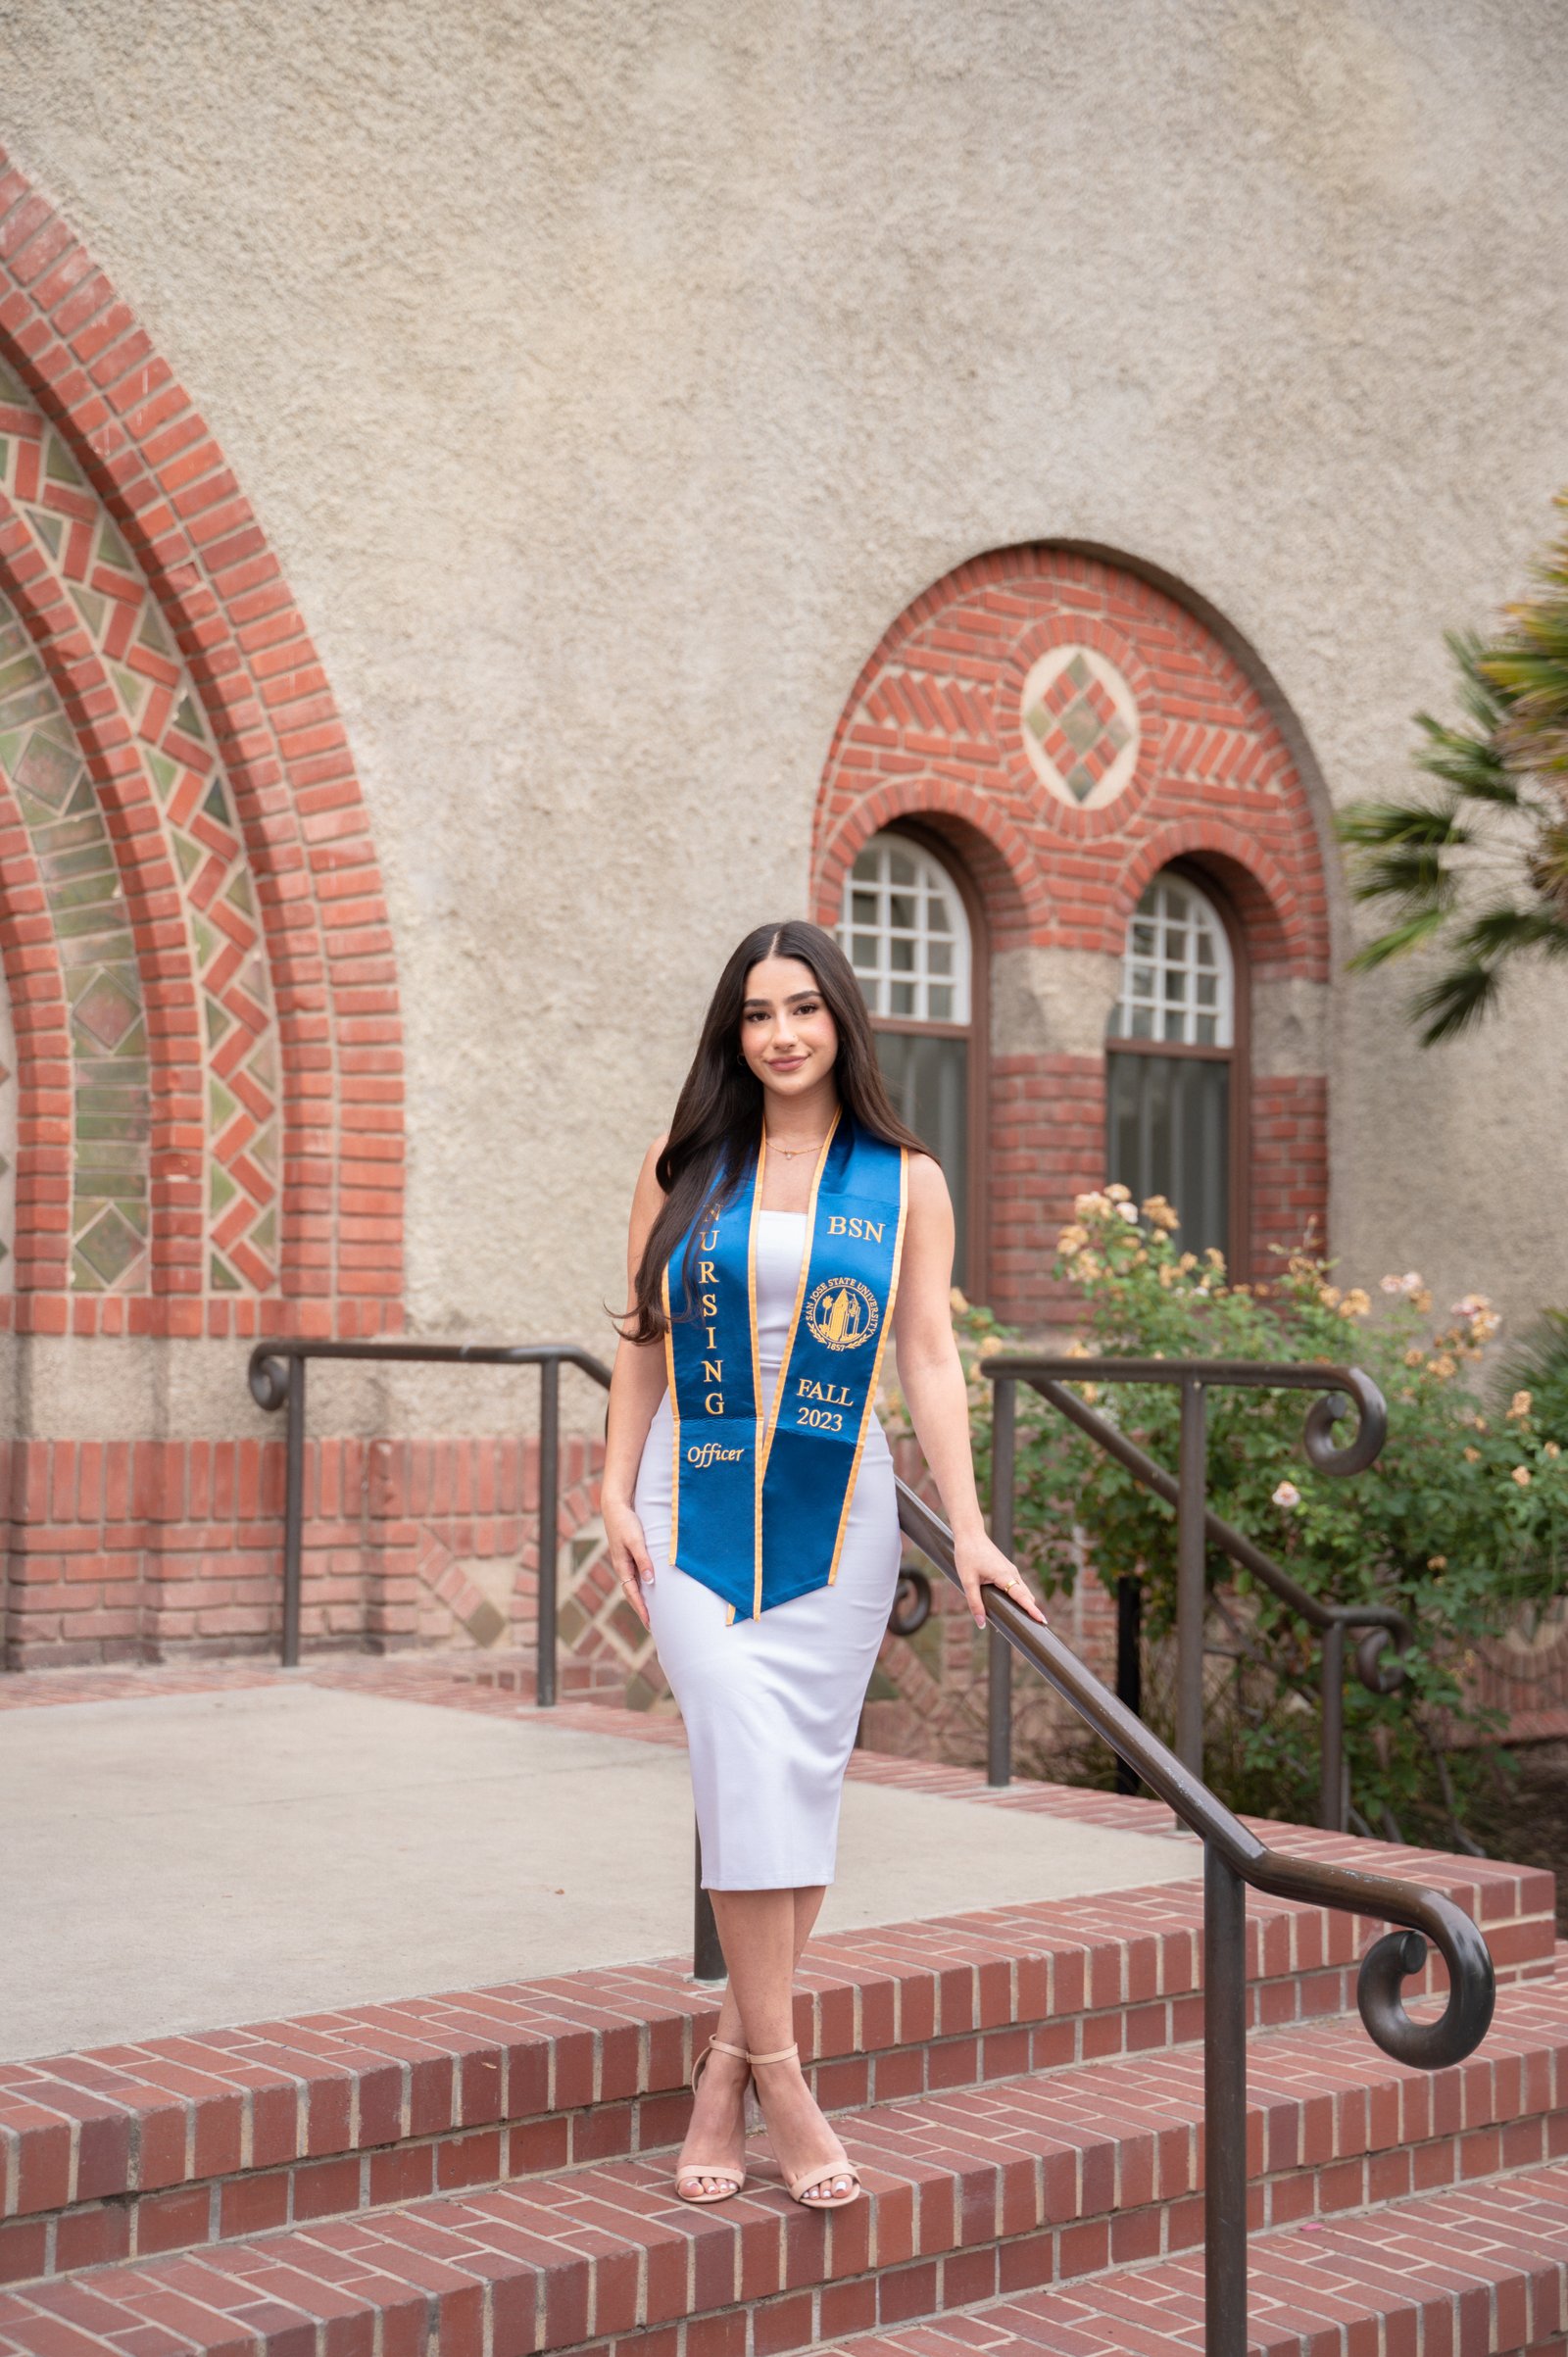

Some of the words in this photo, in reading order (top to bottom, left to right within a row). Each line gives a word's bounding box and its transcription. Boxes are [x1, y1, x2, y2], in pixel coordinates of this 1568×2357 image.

[827, 1215, 886, 1244] BSN
[809, 1282, 828, 1302] JOSE
[827, 1277, 857, 1287] STATE
[806, 1301, 814, 1321] SAN
[857, 1282, 879, 1335] UNIVERSITY
[826, 1342, 846, 1352] 1857
[796, 1378, 855, 1406] FALL
[796, 1406, 843, 1432] 2023
[687, 1443, 745, 1469] Officer
